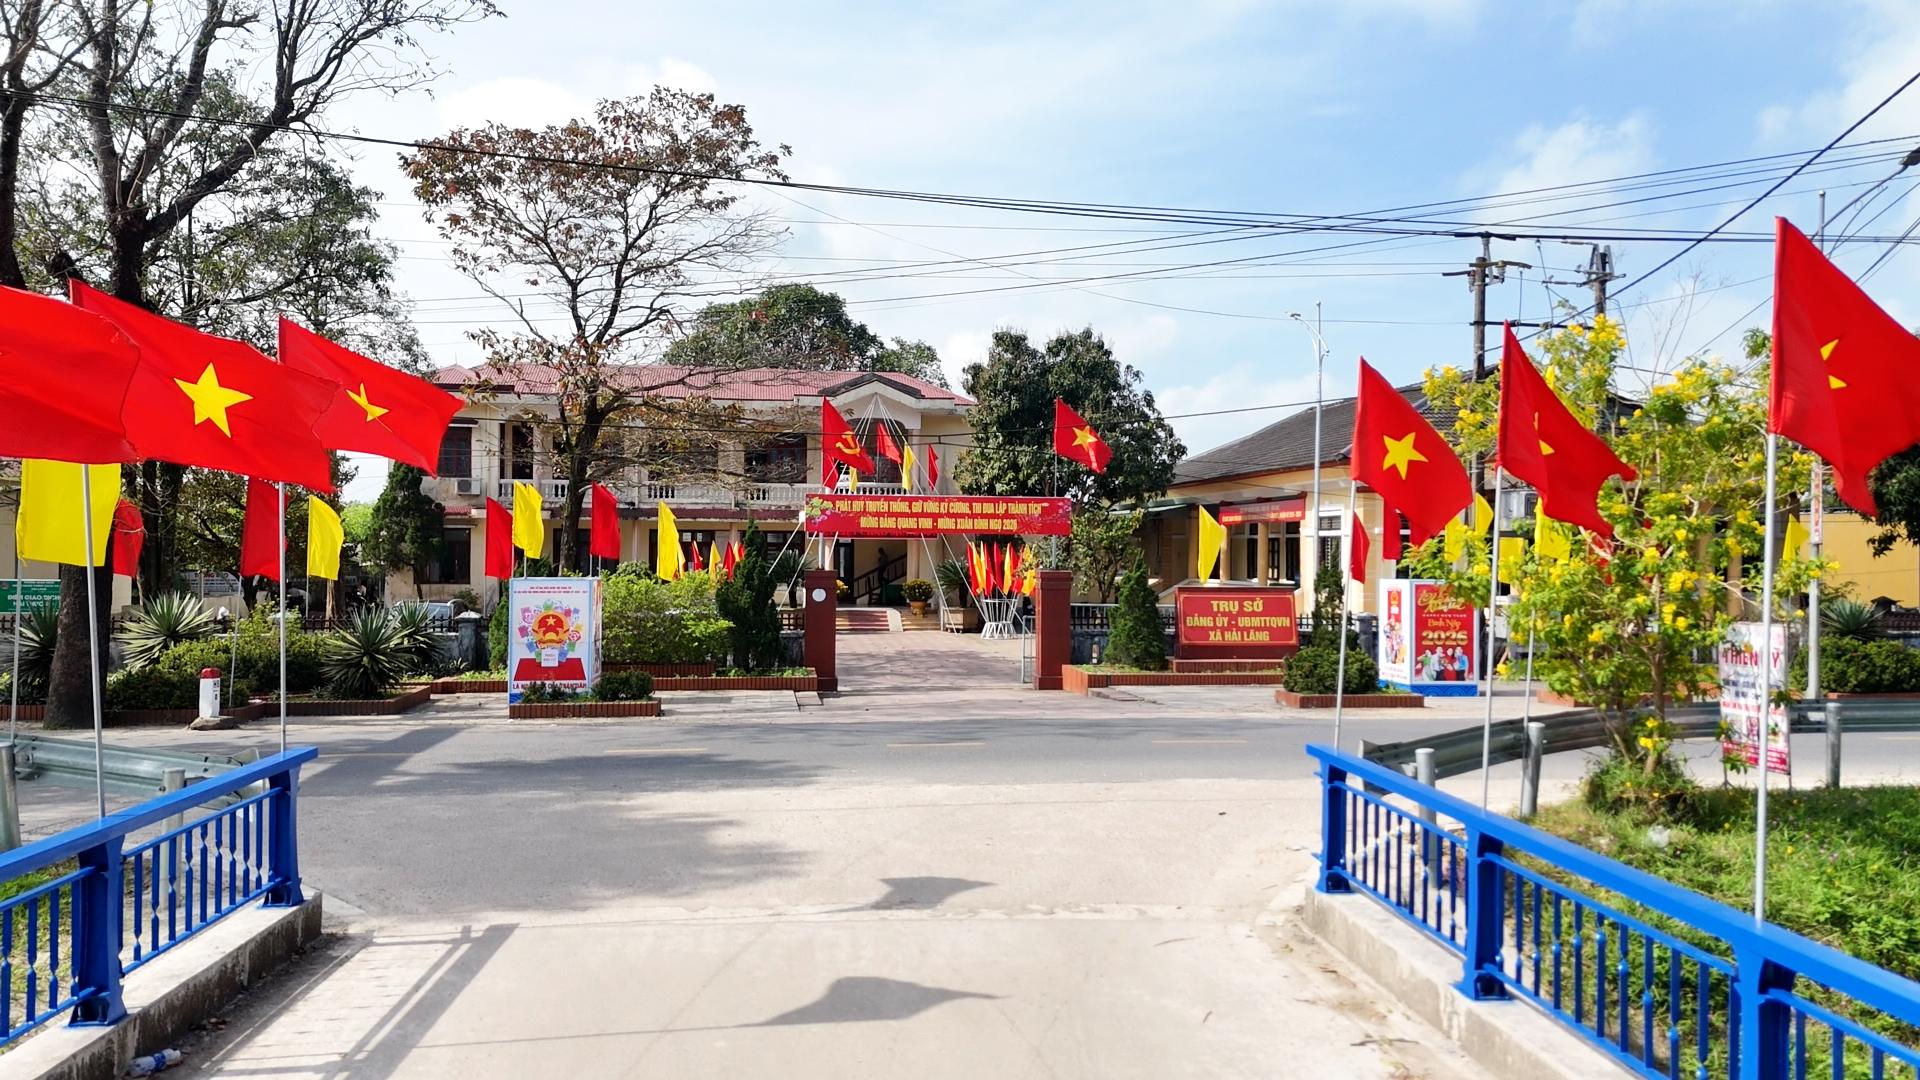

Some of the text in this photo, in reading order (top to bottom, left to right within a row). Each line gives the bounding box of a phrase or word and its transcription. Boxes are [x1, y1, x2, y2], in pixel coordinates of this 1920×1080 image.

[1211, 598, 1264, 614] TRỤ SỞ
[1186, 613, 1214, 627] ĐẢNG
[1216, 613, 1229, 627] ỦY
[1238, 616, 1290, 628] UBMTTQVN
[1209, 628, 1270, 641] XÃ HẢI LĂNG
[1422, 630, 1468, 646] 2026
